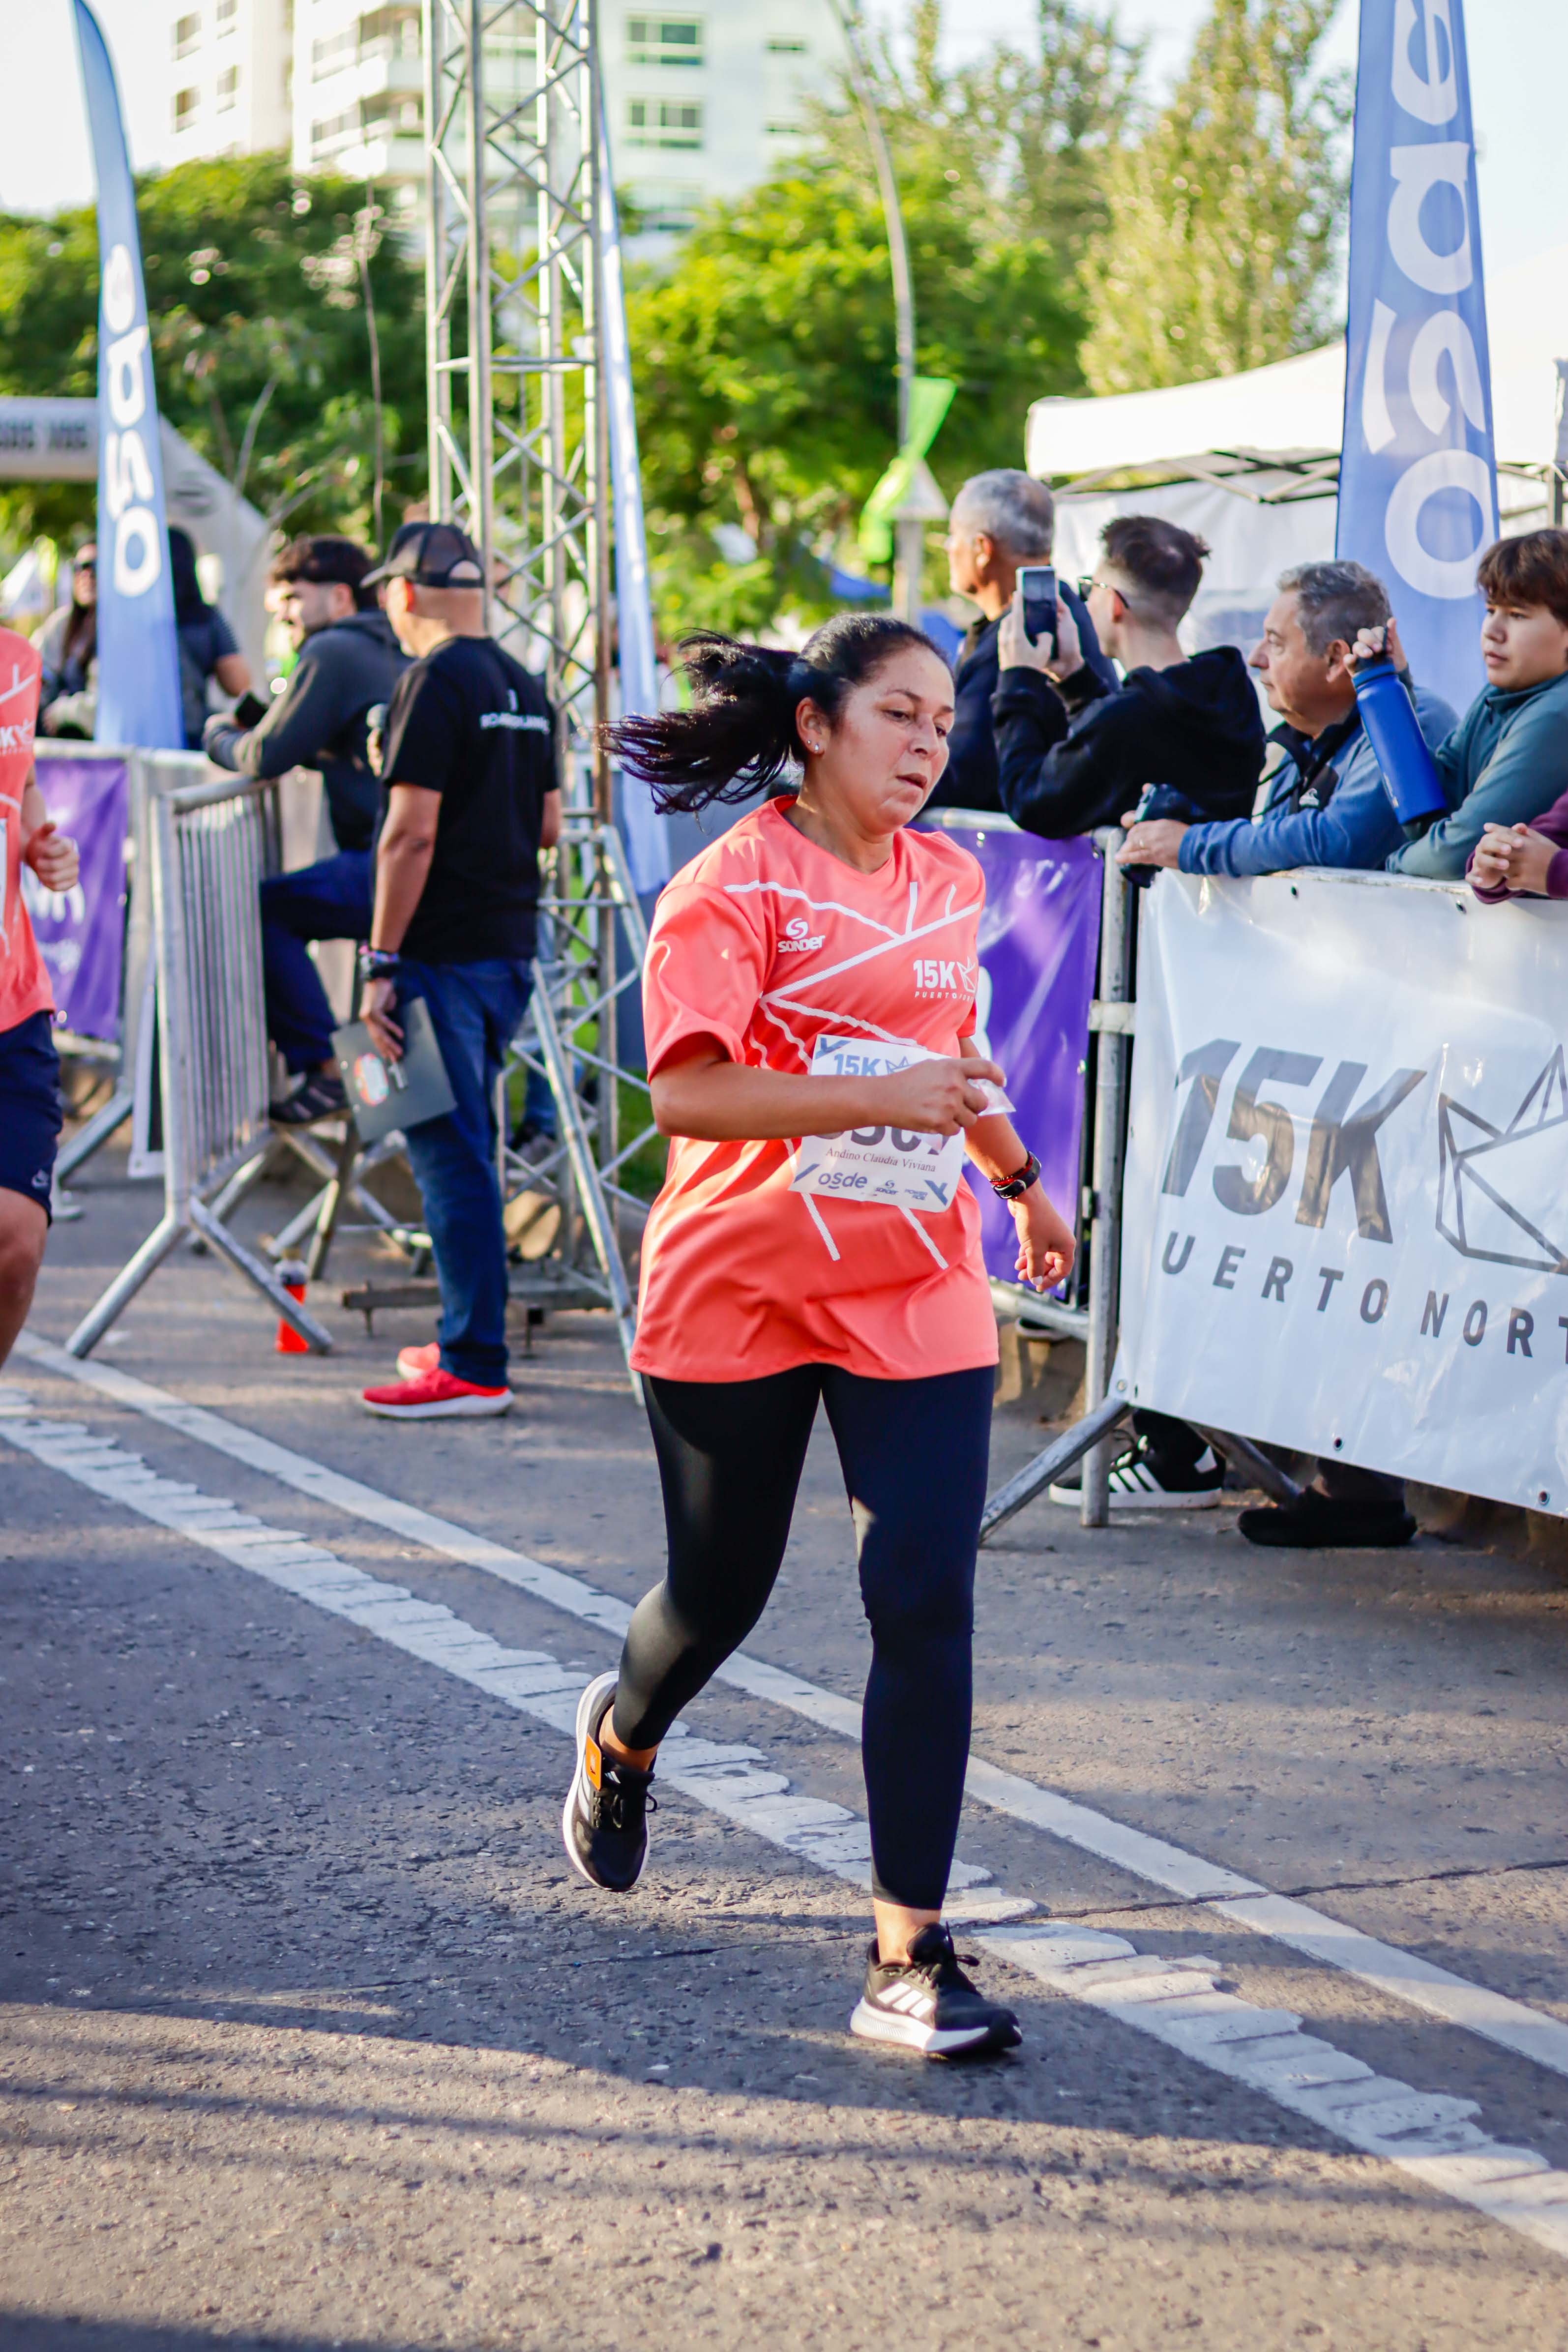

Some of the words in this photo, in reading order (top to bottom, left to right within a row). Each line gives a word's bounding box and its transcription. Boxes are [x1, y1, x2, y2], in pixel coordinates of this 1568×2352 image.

[913, 959, 957, 989] 15K
[915, 991, 957, 999] PUERTO
[834, 1054, 881, 1076] 15K
[1162, 1038, 1427, 1244] 15K
[826, 1147, 860, 1161] Andino
[863, 1152, 898, 1166] Claudia
[902, 1158, 936, 1172] Viviana
[818, 1172, 867, 1189] osde
[1161, 1232, 1389, 1323] UERTO
